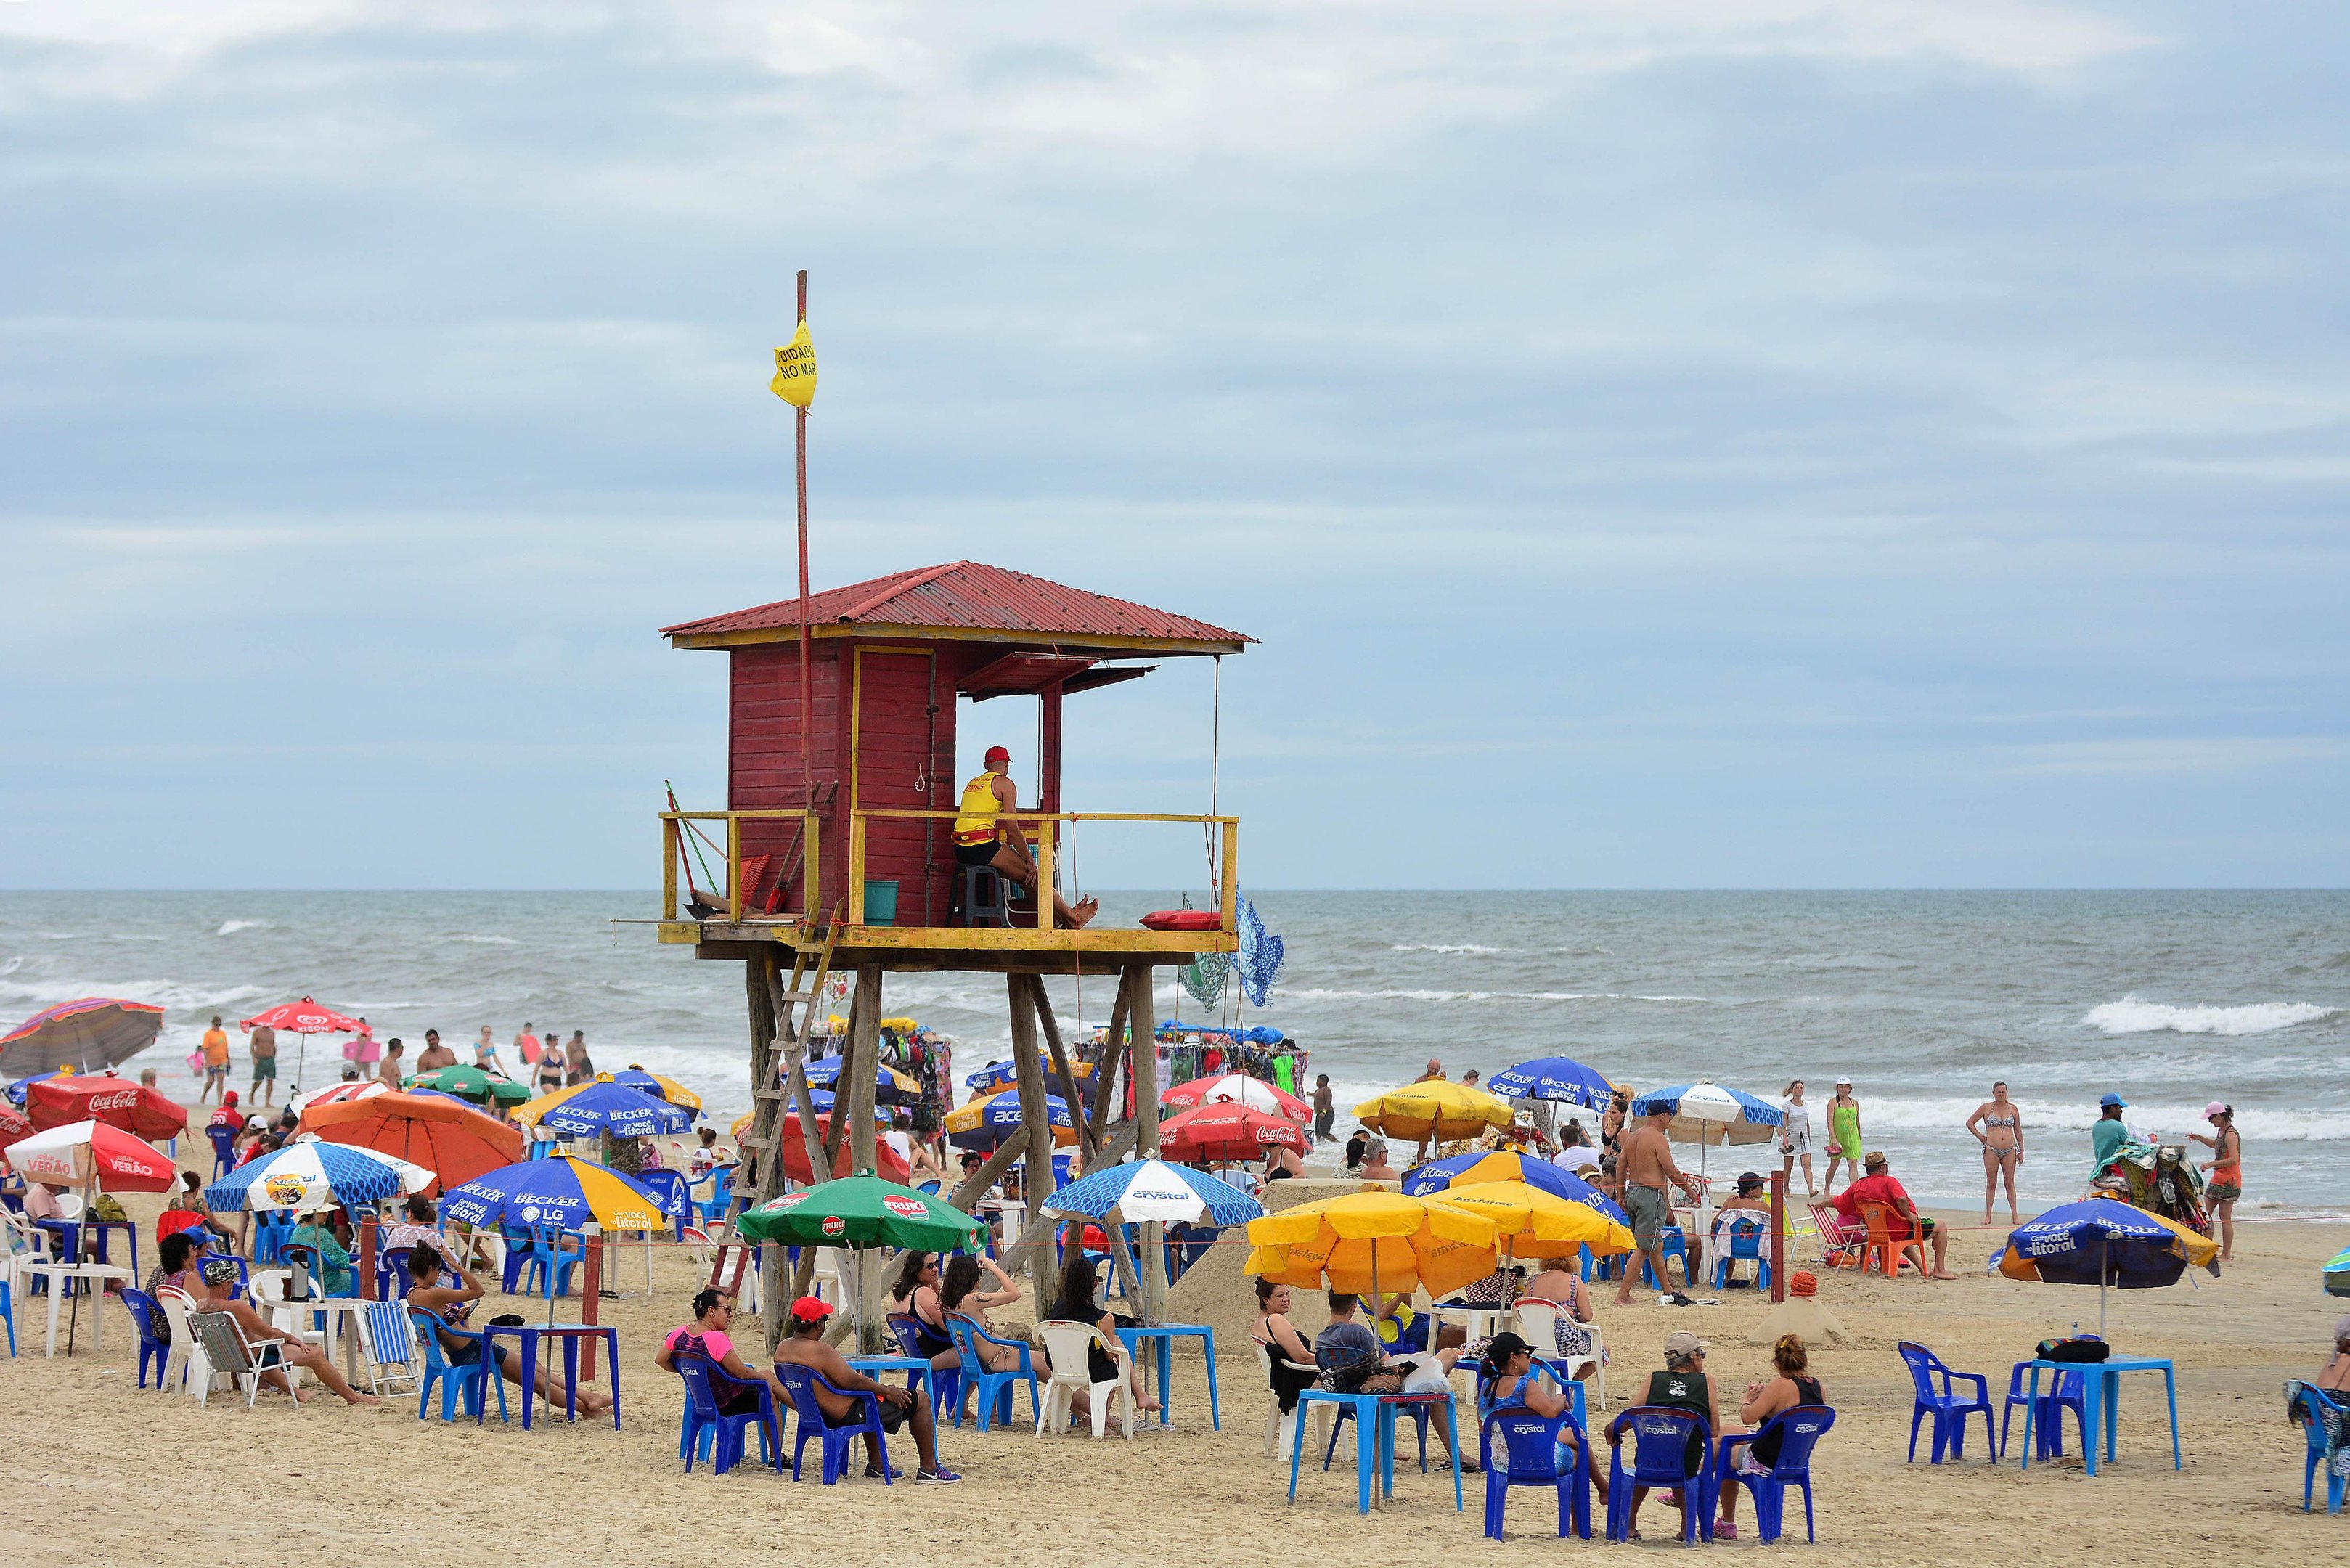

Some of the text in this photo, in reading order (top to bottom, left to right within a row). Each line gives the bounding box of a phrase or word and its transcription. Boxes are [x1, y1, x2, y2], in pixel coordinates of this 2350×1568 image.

[780, 363, 817, 379] NO MAR
[1501, 1072, 1535, 1084] BECKER
[1493, 1082, 1526, 1096] acer
[1541, 1077, 1581, 1093] BECKER
[89, 1090, 139, 1111] Coca-Cola
[555, 1106, 602, 1120] BECKER
[609, 1108, 653, 1121] BECKER
[552, 1118, 595, 1134] acer
[677, 1118, 684, 1128] LG
[955, 1116, 977, 1130] litoral
[624, 1125, 656, 1136] litoral
[1256, 1126, 1297, 1142] Coca-Cola
[27, 1160, 70, 1175] VERÃO
[110, 1158, 152, 1175] VERÃO
[457, 1183, 505, 1203] BECKER
[466, 1201, 488, 1214] você
[514, 1195, 579, 1207] BECKER
[884, 1200, 925, 1212] FRUKI
[1453, 1196, 1514, 1206] Agafarma
[449, 1203, 486, 1224] litoral
[543, 1209, 563, 1220] LG
[624, 1210, 646, 1219] você
[616, 1215, 653, 1228] litoral
[822, 1220, 845, 1230] FRUKI
[2097, 1218, 2160, 1234] BECKER
[2044, 1230, 2070, 1243] você
[2032, 1237, 2077, 1256] litoral
[1514, 1424, 1545, 1434] crystal
[1646, 1426, 1677, 1434] crystal
